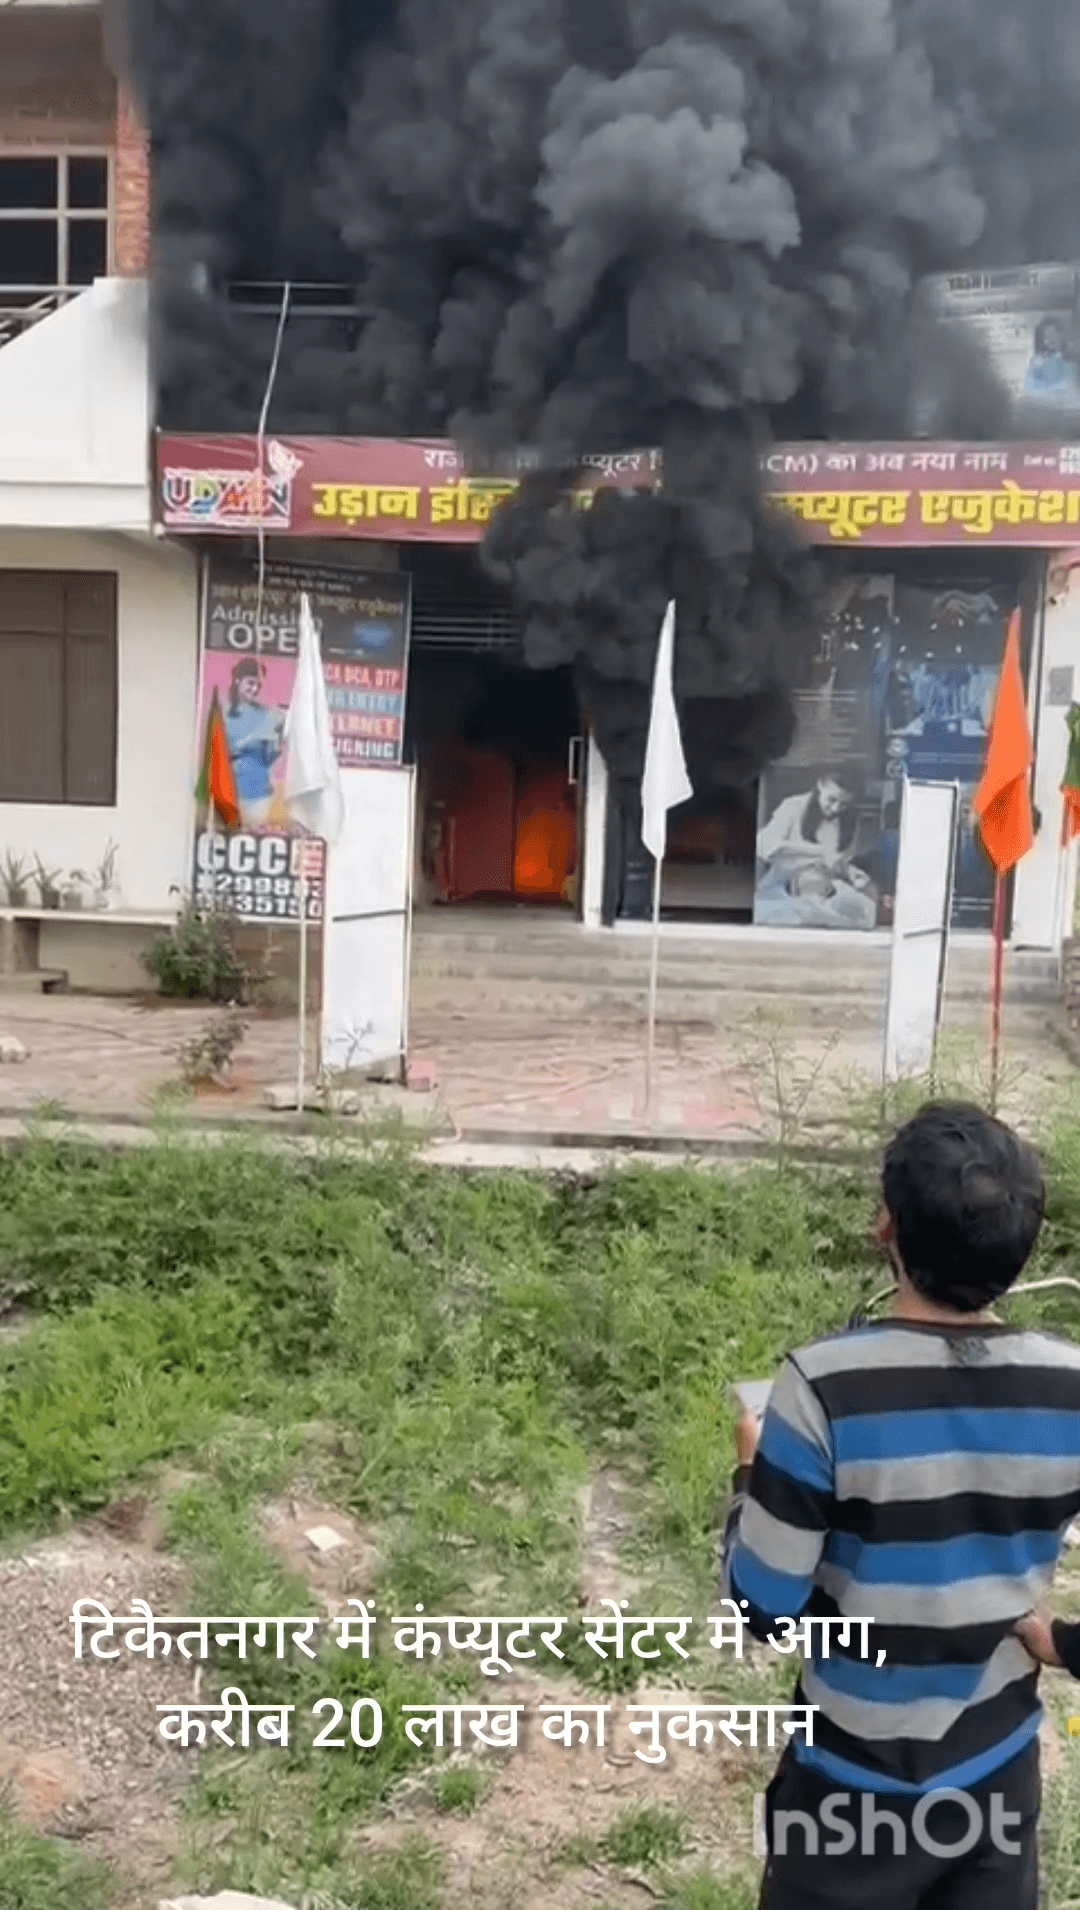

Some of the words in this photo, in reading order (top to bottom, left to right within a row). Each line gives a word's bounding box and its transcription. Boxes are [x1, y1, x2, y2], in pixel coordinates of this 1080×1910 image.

[824, 453, 857, 472] का
[911, 451, 956, 472] नया
[963, 450, 1008, 472] नाम
[312, 482, 420, 525] उड़ान
[211, 604, 324, 631] Admissin
[227, 622, 298, 653] OPE
